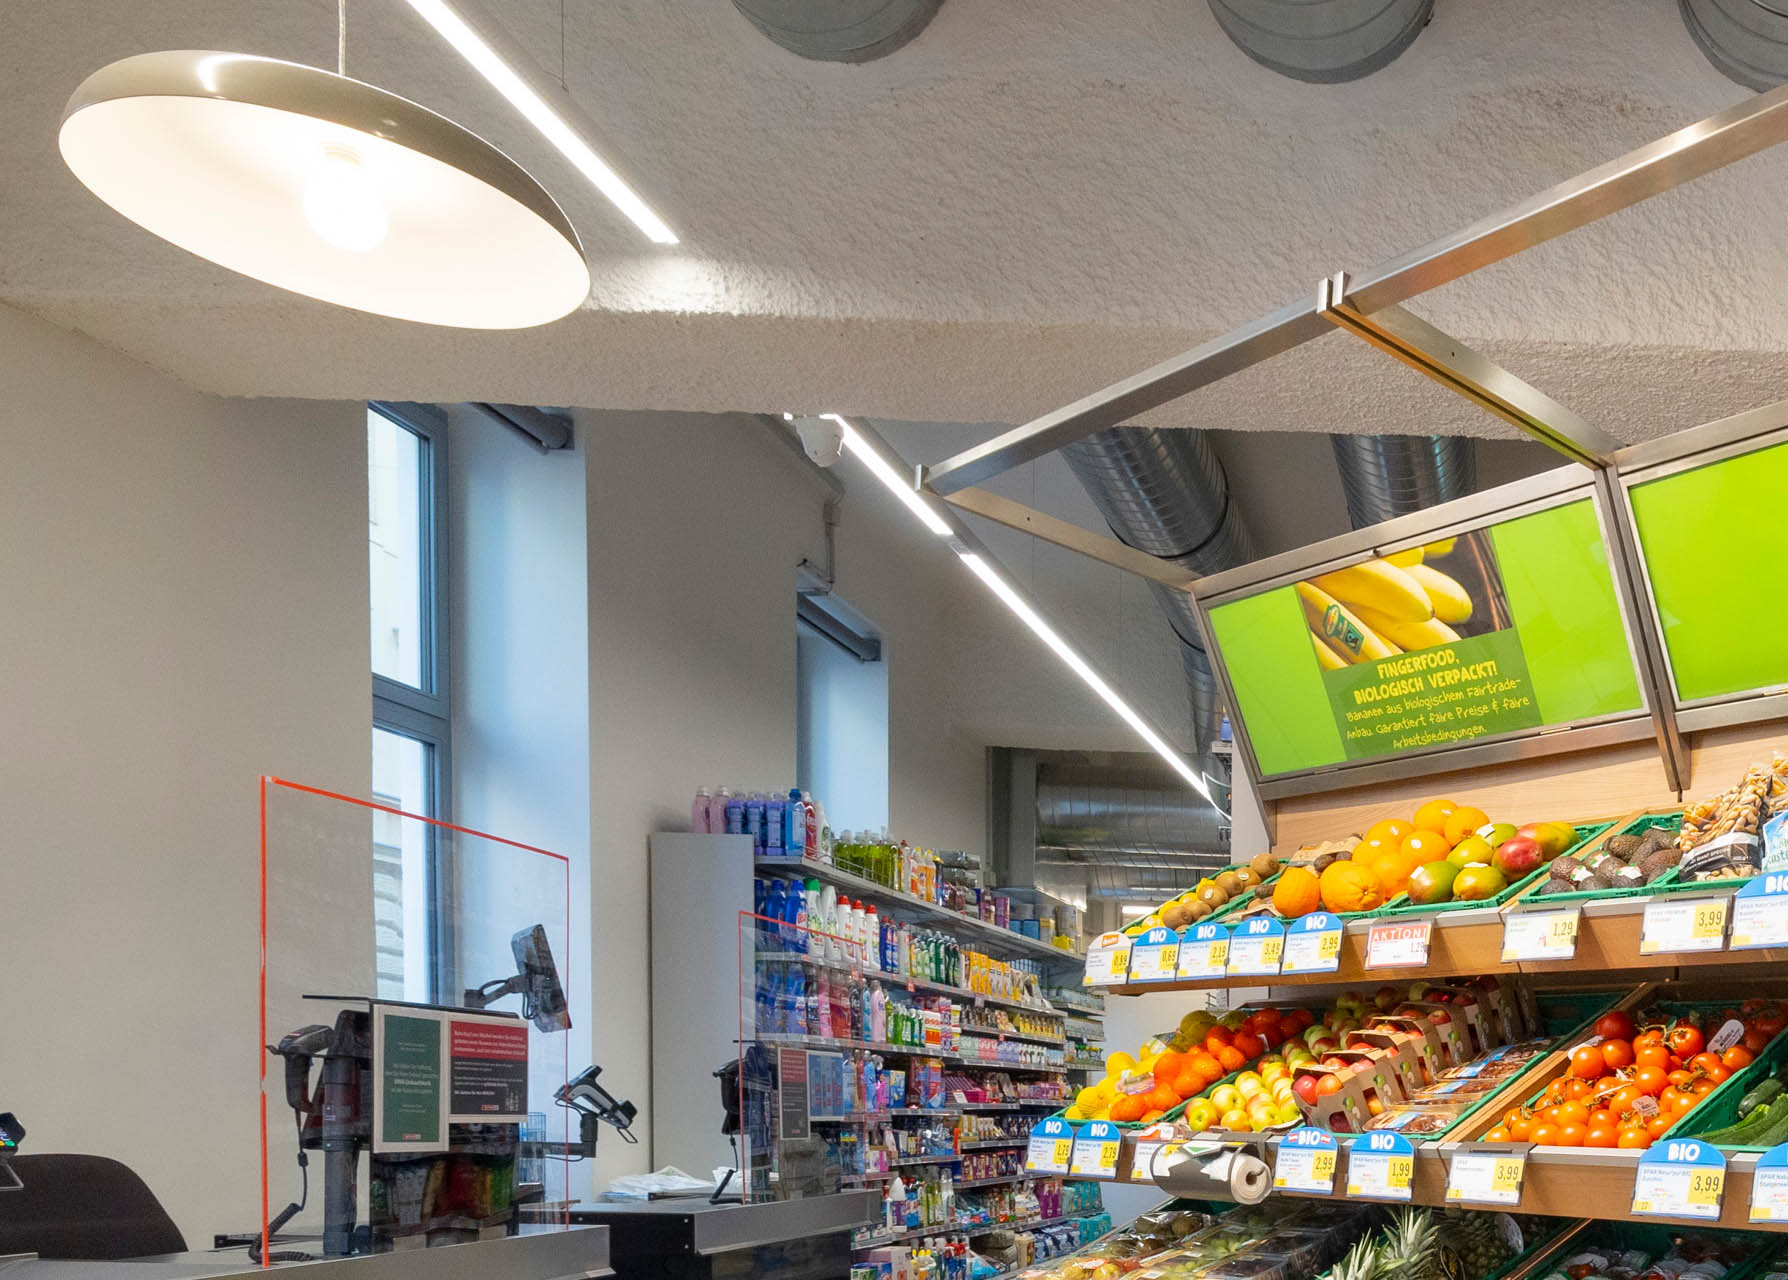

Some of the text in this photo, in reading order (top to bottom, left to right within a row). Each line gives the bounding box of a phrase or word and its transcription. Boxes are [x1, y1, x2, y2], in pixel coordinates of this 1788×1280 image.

[1377, 649, 1460, 679] FINGERFOOD,
[1354, 661, 1498, 704] BIOLOGISCH VERPACKT!
[1346, 679, 1521, 722] Bananen aus biologischem Fairtrade-
[1376, 716, 1427, 734] Garantiert
[1429, 711, 1453, 723] faire
[1456, 705, 1489, 719] Preise
[1502, 696, 1529, 709] faire
[1393, 726, 1487, 748] Arbeitsbedingungen.
[1306, 915, 1326, 929] BIO
[1372, 927, 1427, 942] AKTION!
[1045, 1121, 1062, 1134] BIO
[1091, 1124, 1108, 1136] BIO
[1298, 1131, 1320, 1145] BIO
[1370, 1135, 1394, 1149] BIO
[1668, 1144, 1700, 1161] BIO
[1694, 1176, 1719, 1192] 3,99
